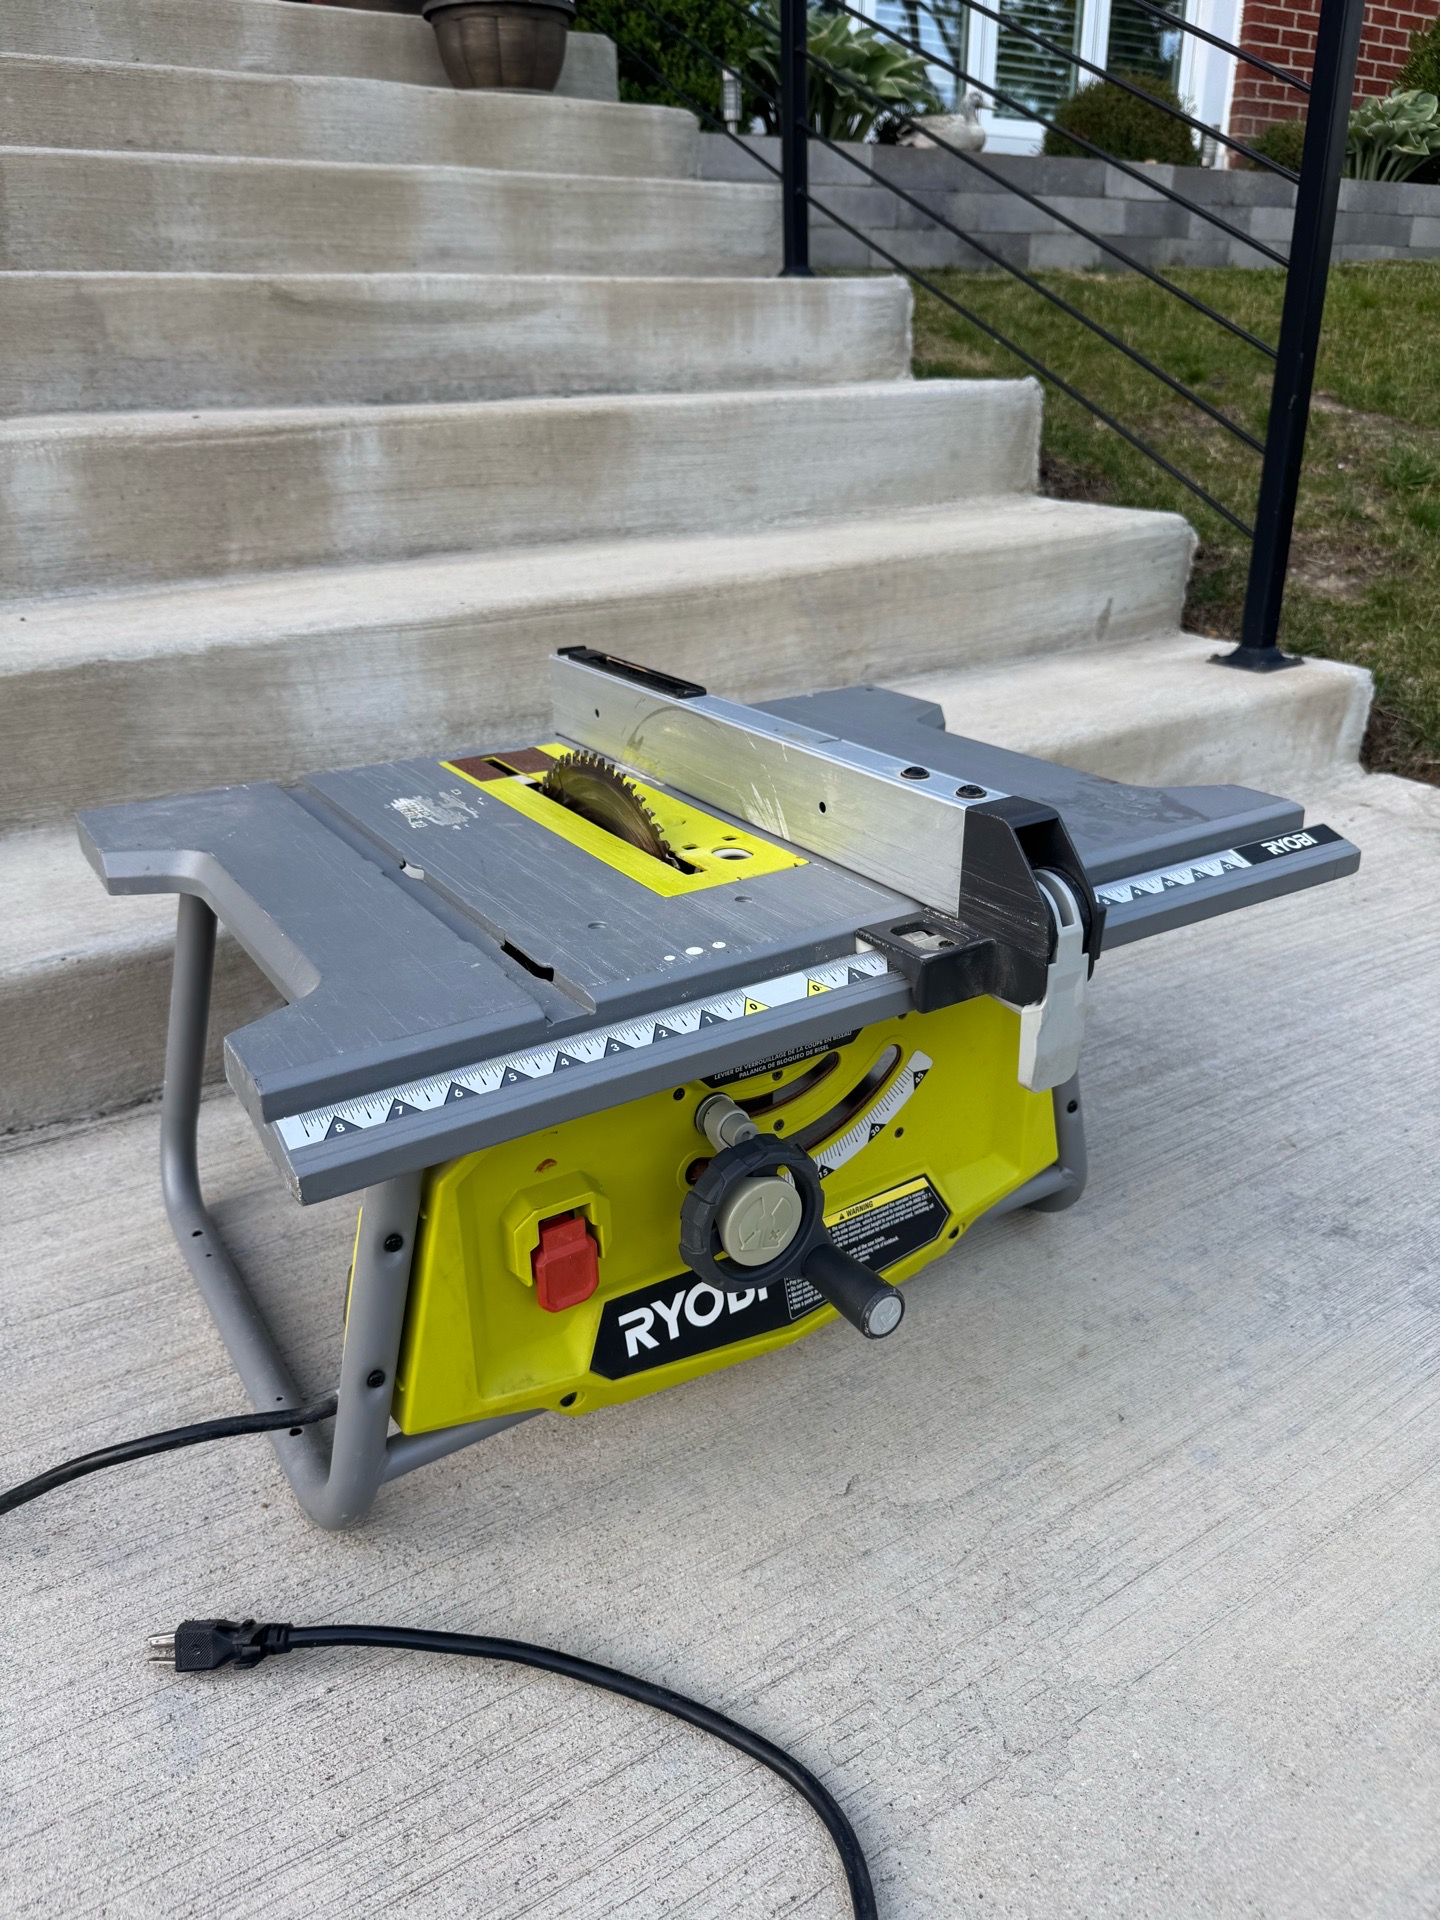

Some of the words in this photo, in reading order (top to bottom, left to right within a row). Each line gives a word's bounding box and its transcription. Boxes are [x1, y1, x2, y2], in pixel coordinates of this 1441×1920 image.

[1261, 832, 1318, 855] RYOBI
[812, 984, 821, 992] 0
[852, 971, 862, 981] 1
[335, 1122, 346, 1133] 8
[395, 1105, 404, 1115] 7
[454, 1089, 464, 1098] 6
[508, 1072, 518, 1082] 5
[560, 1057, 570, 1067] 4
[610, 1042, 620, 1052] 3
[659, 1028, 669, 1039] 2
[705, 1015, 713, 1024] 1
[749, 1003, 758, 1011] 0
[714, 1069, 735, 1080] LEVIER
[735, 1065, 744, 1074] DE
[787, 1049, 796, 1057] DE
[796, 1046, 804, 1054] LA
[739, 1064, 767, 1079] PALANCA
[767, 1060, 776, 1069] DE
[776, 1052, 805, 1067] BLOQUEO
[805, 1049, 814, 1058] DE
[814, 1044, 829, 1054] BISEL
[915, 1072, 924, 1084] 45
[870, 1125, 880, 1137] 30
[819, 1168, 829, 1178] 15
[846, 1200, 874, 1217] WARNING
